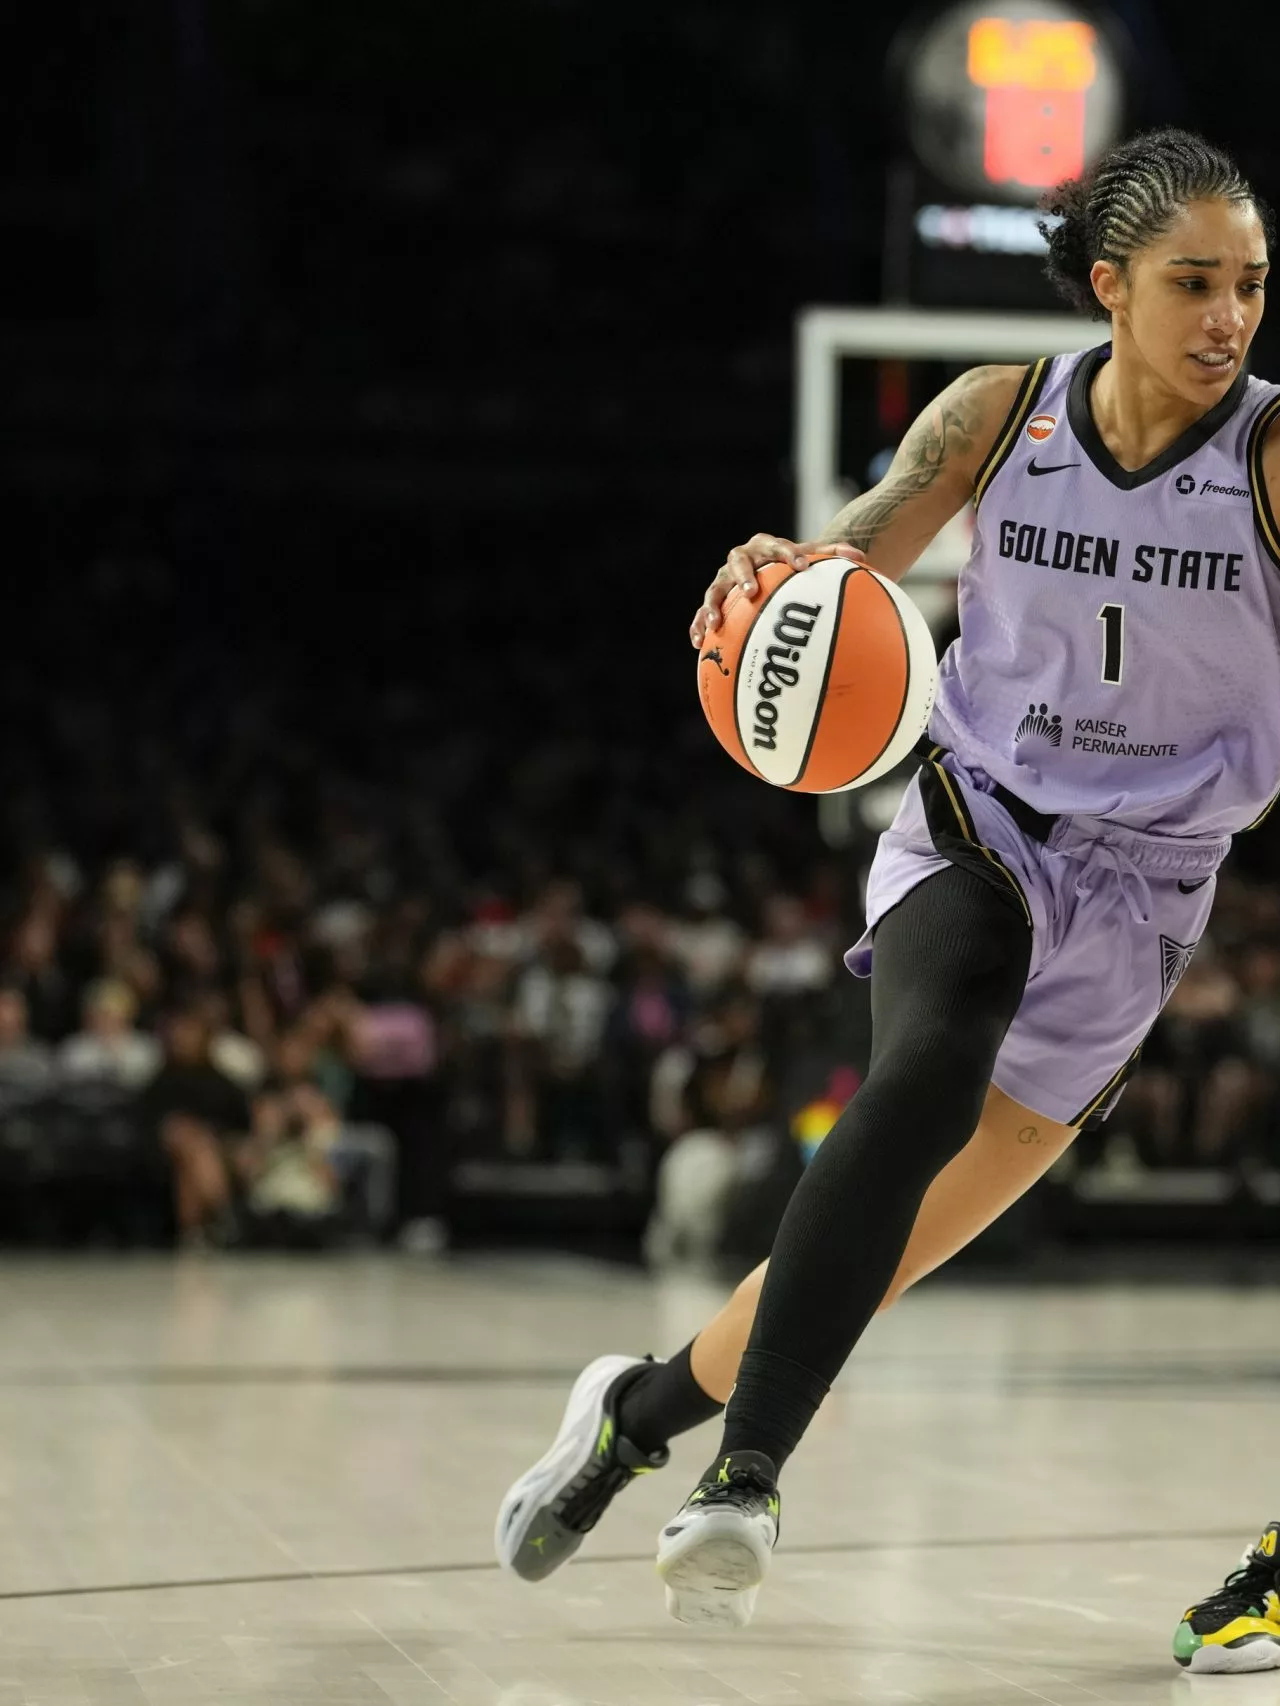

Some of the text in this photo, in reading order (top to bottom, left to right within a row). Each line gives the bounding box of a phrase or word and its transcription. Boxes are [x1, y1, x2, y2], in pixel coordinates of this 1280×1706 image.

[1199, 480, 1250, 498] freedom
[999, 519, 1243, 592] GOLDEN STATE
[1096, 602, 1125, 687] 1
[753, 601, 823, 752] Wilson
[1072, 736, 1179, 757] PERMANENTE
[1075, 718, 1127, 738] KAISER
